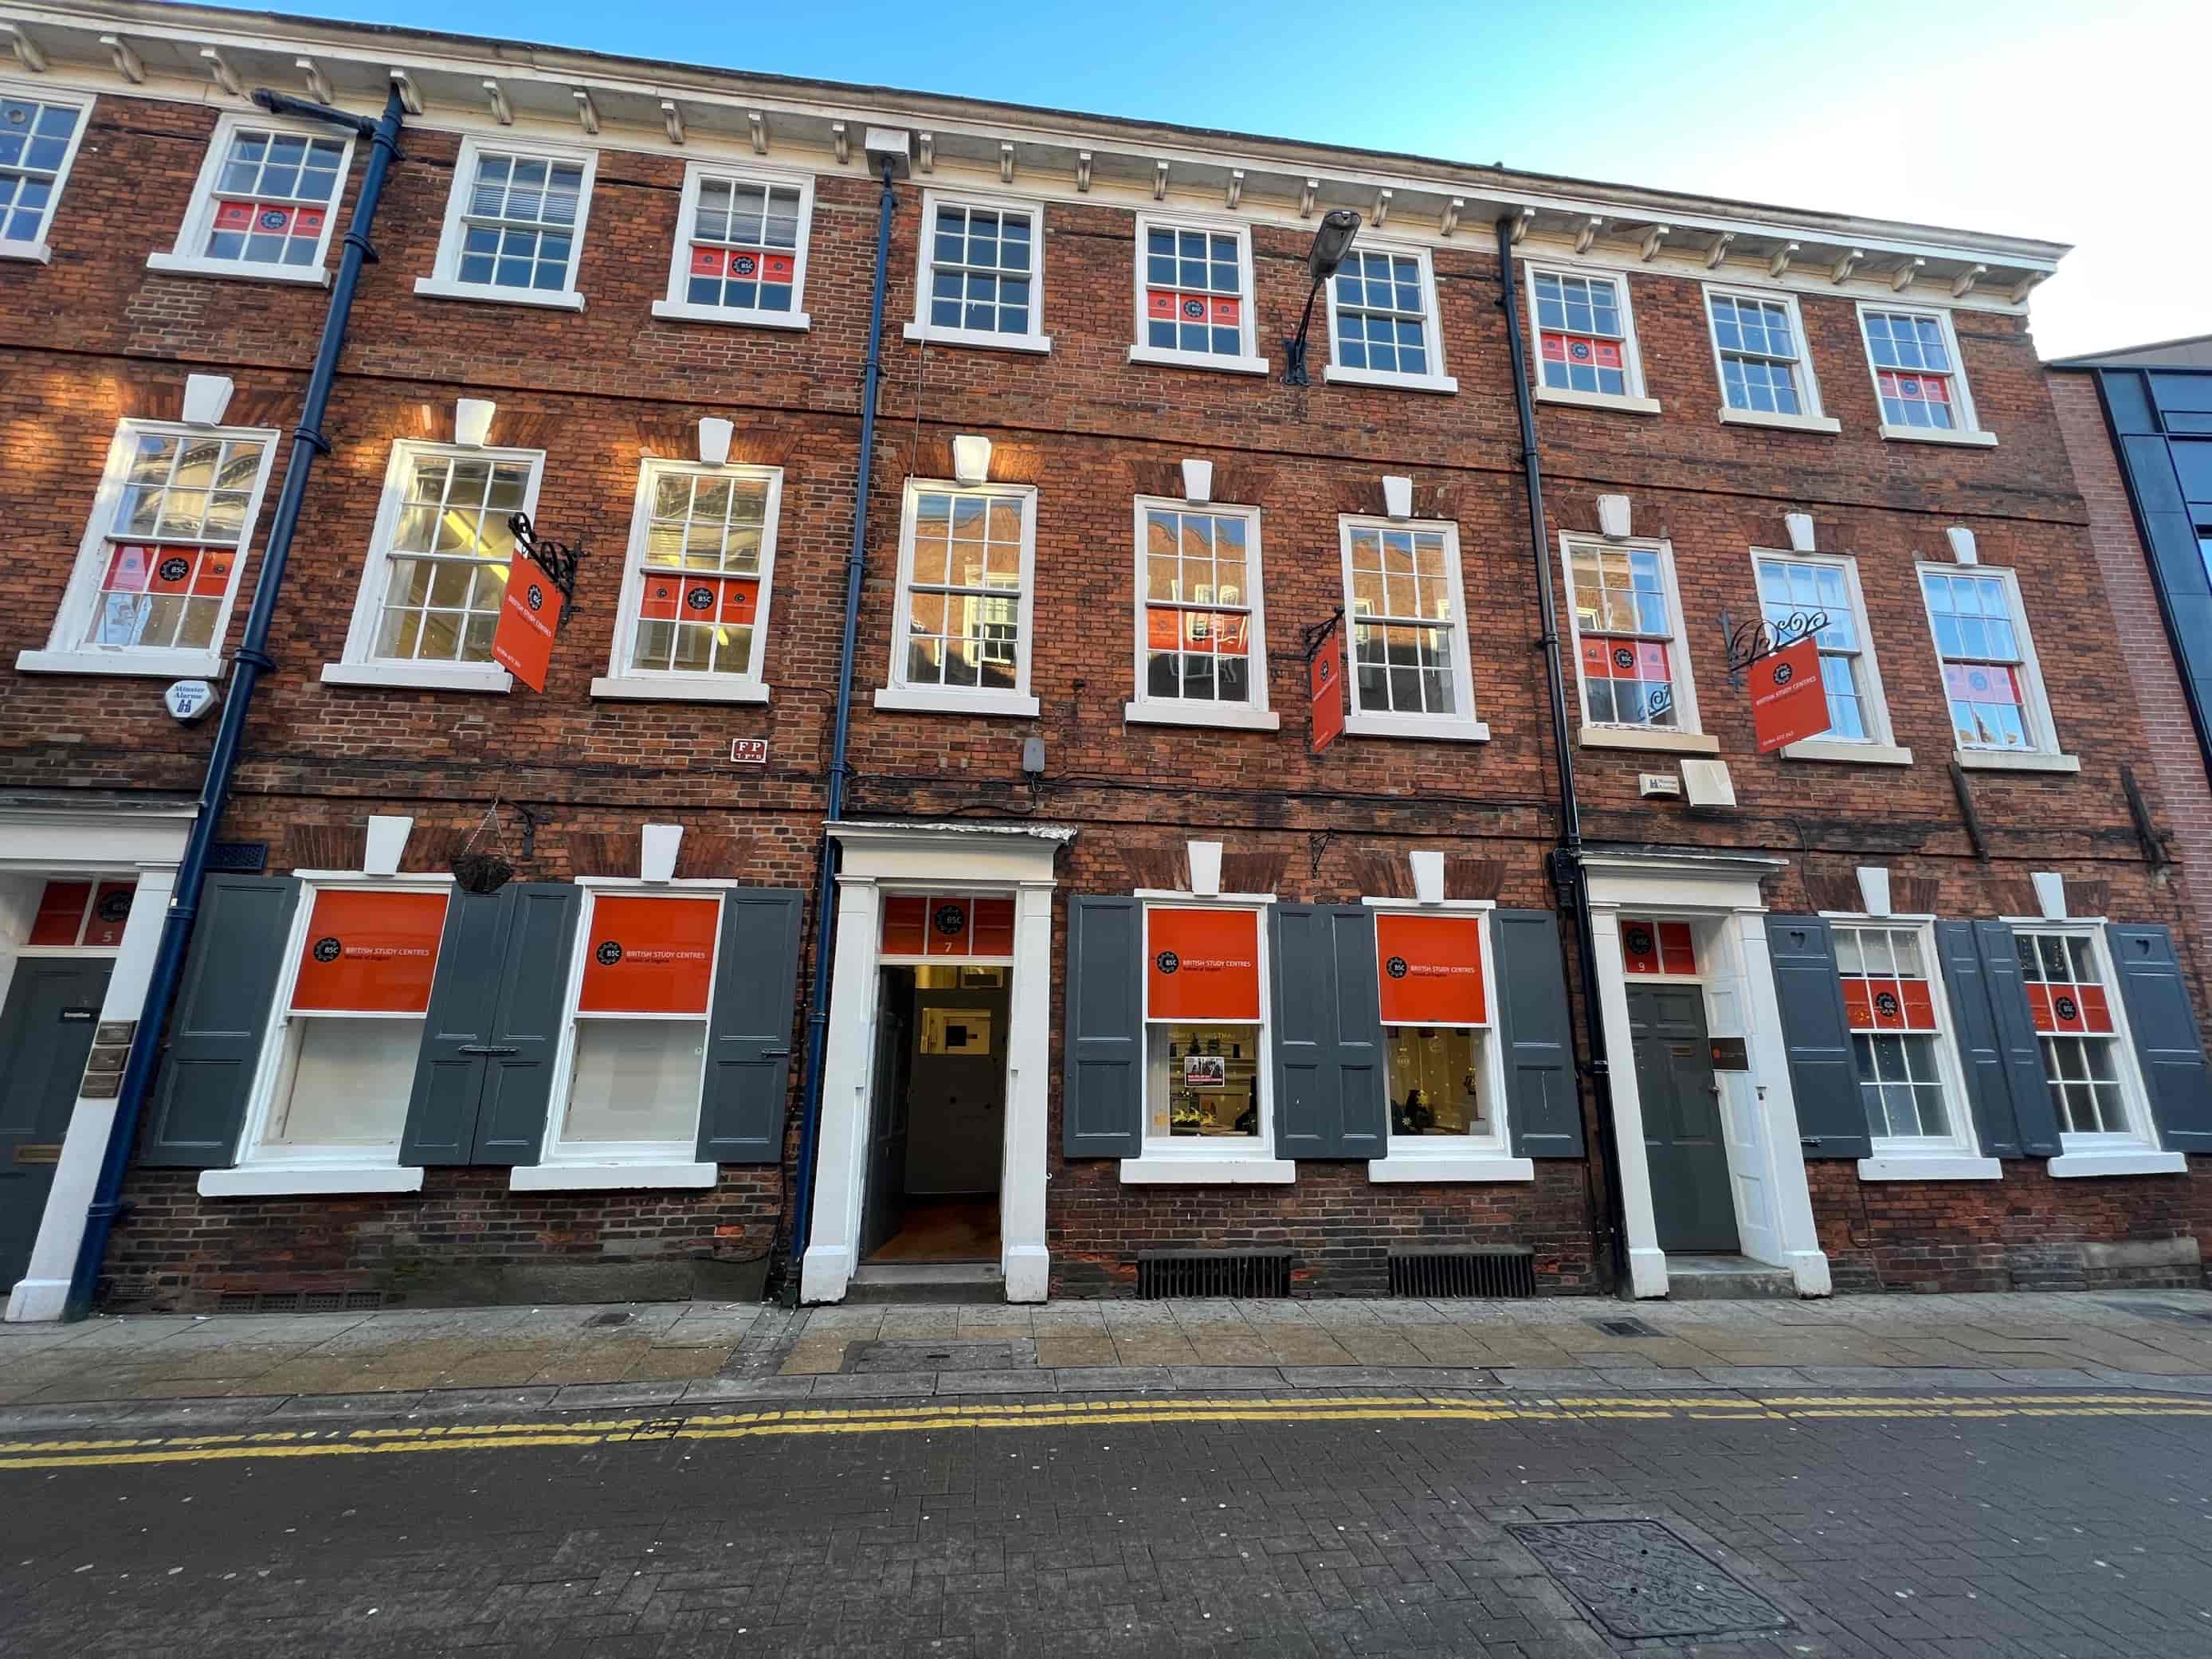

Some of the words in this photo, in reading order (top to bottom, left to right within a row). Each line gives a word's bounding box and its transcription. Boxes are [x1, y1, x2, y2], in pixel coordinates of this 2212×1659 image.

[739, 742, 749, 751] F
[751, 742, 762, 752] P
[102, 931, 114, 942] 5
[945, 943, 953, 952] 7
[677, 951, 705, 959] CENTRES
[1638, 962, 1645, 971] 9
